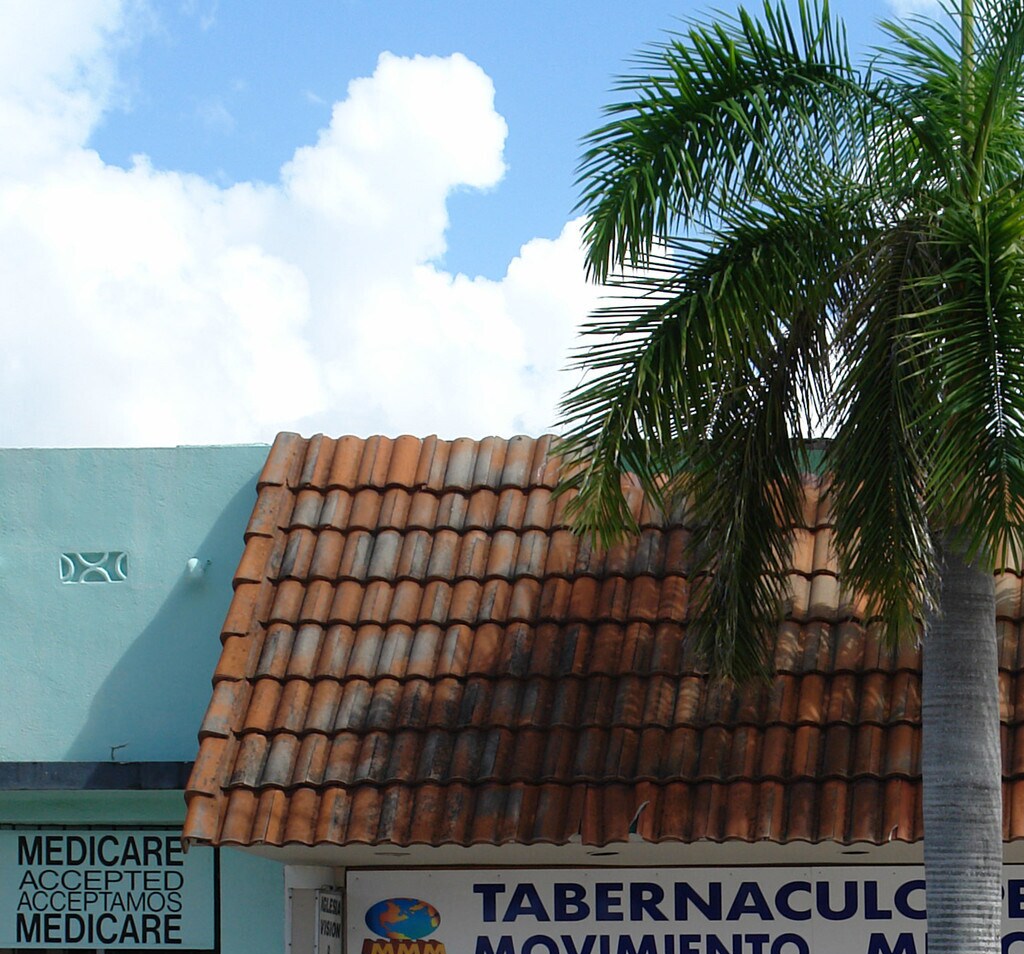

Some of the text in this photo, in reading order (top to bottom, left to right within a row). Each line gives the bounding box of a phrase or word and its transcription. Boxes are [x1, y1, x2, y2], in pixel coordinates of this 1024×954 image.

[18, 835, 184, 866] MEDICARE
[19, 870, 184, 890] ACCEPTED
[17, 891, 182, 912] ACCEPTAMOS
[473, 880, 926, 922] TABERNACULO
[16, 913, 182, 944] MEDICARE
[320, 920, 340, 938] VISION
